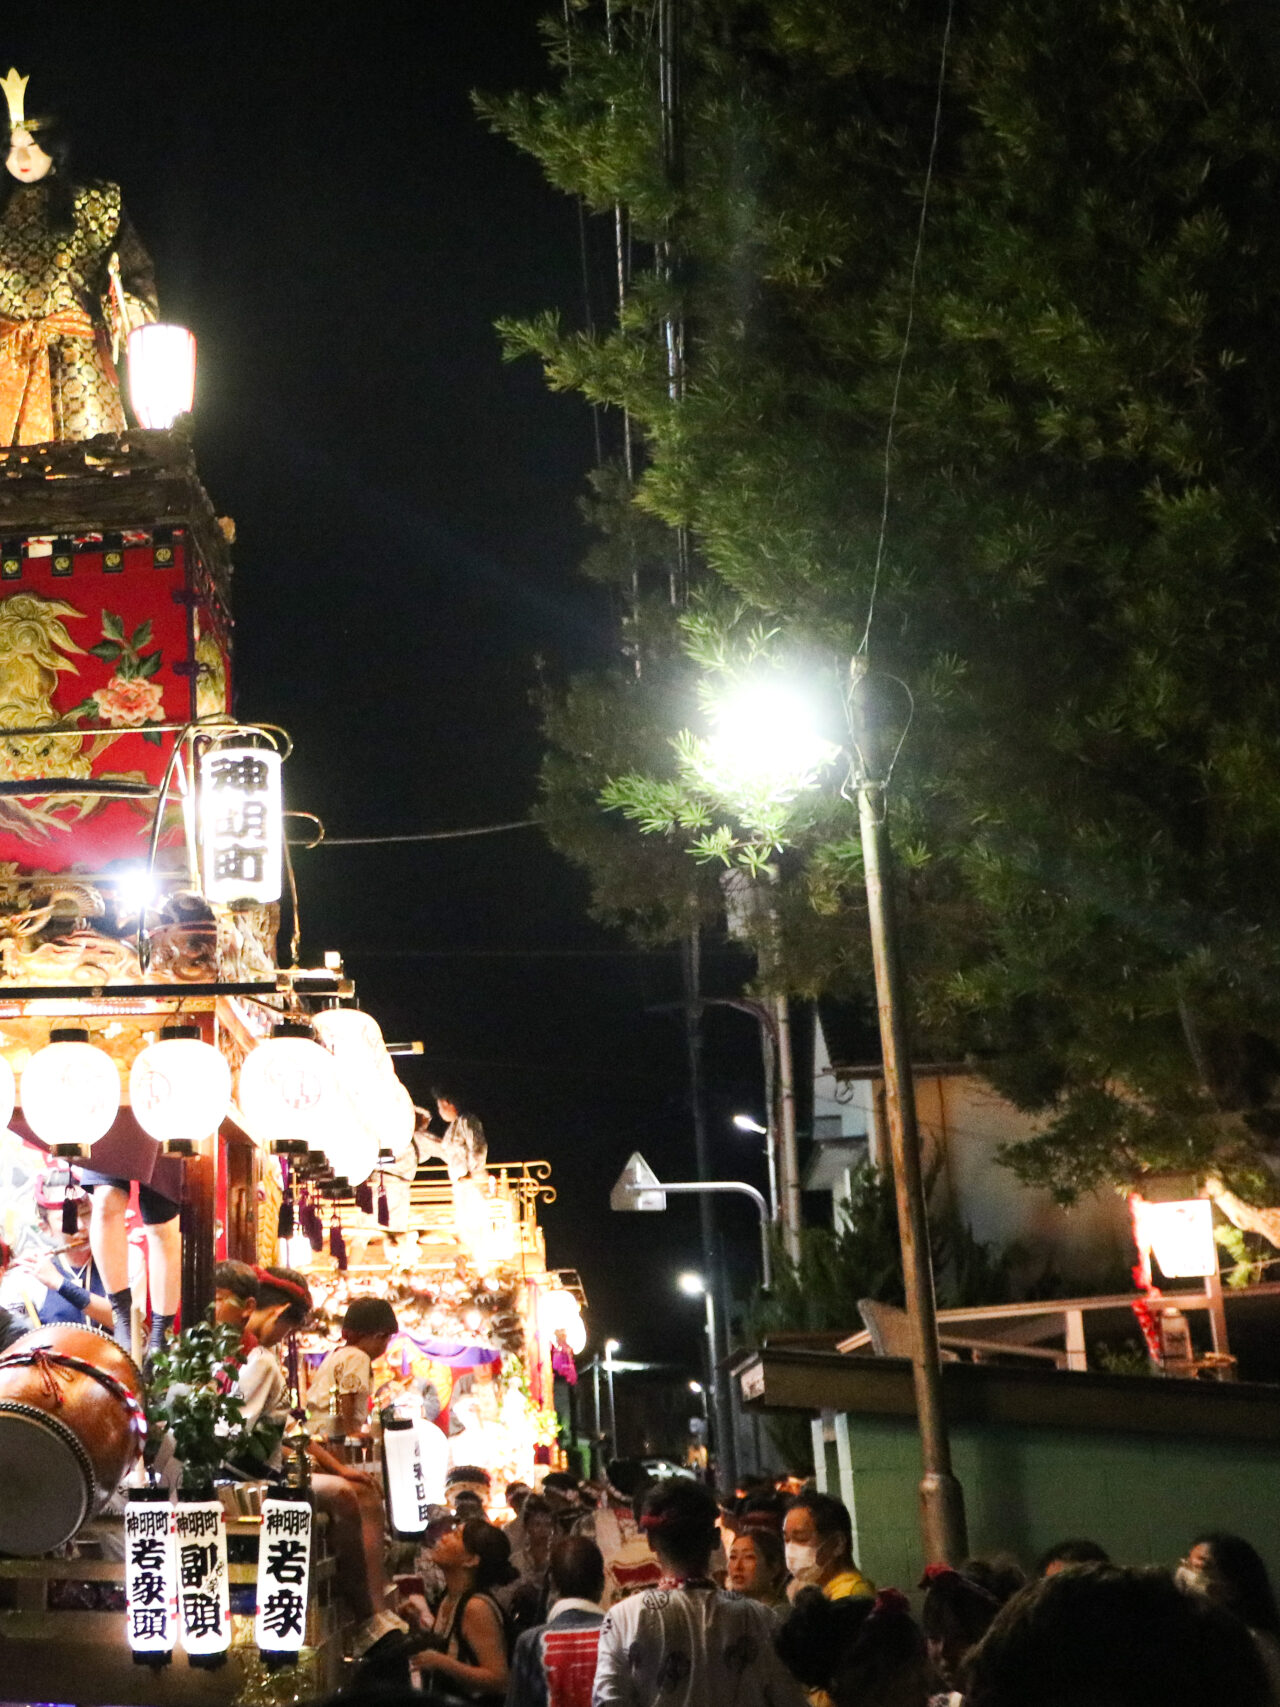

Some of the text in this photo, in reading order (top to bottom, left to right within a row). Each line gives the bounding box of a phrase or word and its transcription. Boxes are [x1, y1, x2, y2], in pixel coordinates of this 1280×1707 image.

[210, 755, 269, 883] 神明町
[126, 1510, 169, 1538] 神明町
[176, 1510, 219, 1538] 神明町
[266, 1508, 310, 1537] 神明町
[131, 1538, 168, 1640] 若衆頭
[180, 1541, 223, 1638] 副頭
[263, 1539, 308, 1638] 若衆
